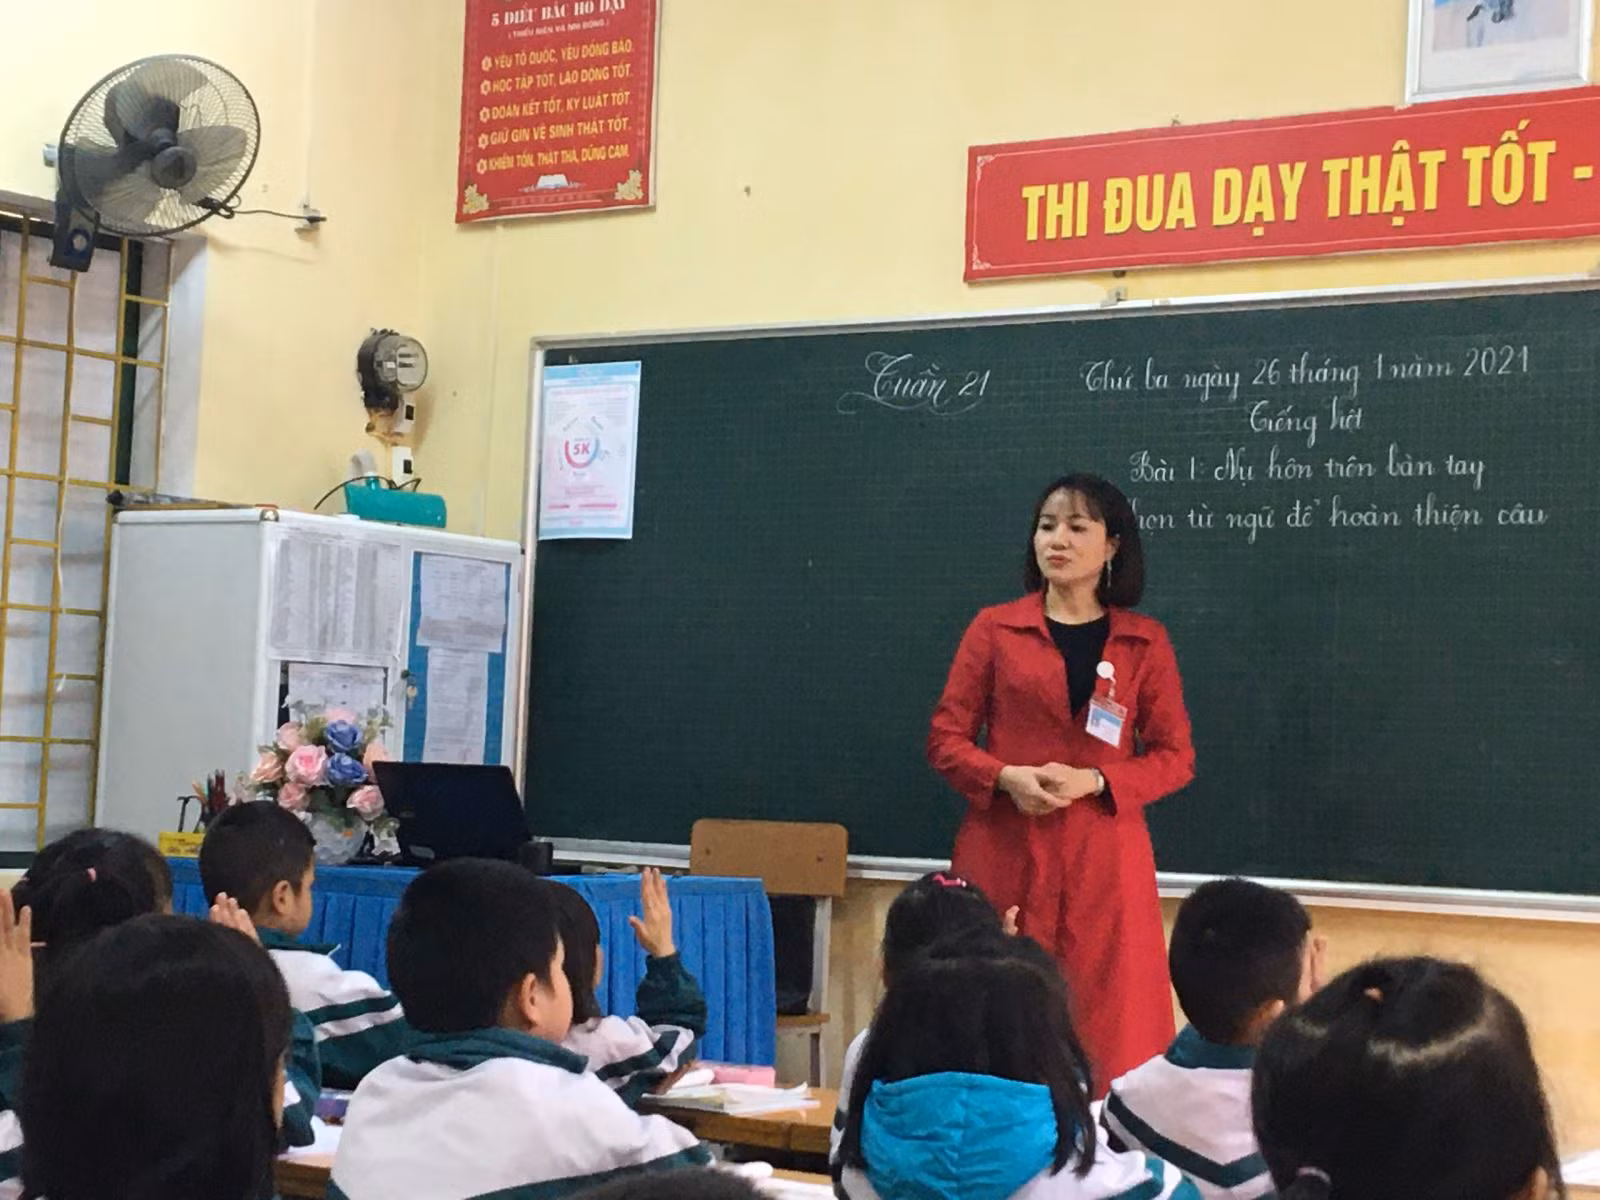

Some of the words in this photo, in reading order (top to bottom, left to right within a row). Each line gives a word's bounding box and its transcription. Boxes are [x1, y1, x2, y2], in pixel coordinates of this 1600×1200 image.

[491, 12, 500, 27] 5
[1022, 181, 1089, 241] THI
[1103, 171, 1197, 234] ĐUA
[1212, 160, 1308, 237] DẠY
[1321, 139, 1447, 226] THẬT
[1462, 119, 1557, 208] TỐT
[856, 350, 948, 412] Tuần
[958, 369, 990, 397] 21
[1081, 358, 1134, 391] Thứ
[1146, 357, 1169, 390] ba
[1184, 362, 1240, 402] ngày
[1252, 358, 1281, 385] 26
[1290, 351, 1361, 398] tháng
[1390, 354, 1454, 378] năm
[1464, 345, 1529, 376] 2021
[573, 443, 590, 455] 5K
[1248, 400, 1318, 448] Tiếng
[1129, 450, 1175, 482] Bài
[1214, 447, 1256, 487] Nụ
[1268, 444, 1313, 480] hôn
[1324, 455, 1377, 478] trên
[1387, 441, 1435, 477] bàn
[1446, 454, 1486, 490] tay
[1127, 497, 1175, 536] họn
[1187, 503, 1215, 529] từ
[1225, 506, 1275, 545] ngữ
[1286, 498, 1321, 528] để
[1329, 494, 1402, 528] hoàn
[1413, 491, 1484, 533] thiện
[1497, 503, 1549, 527] câu
